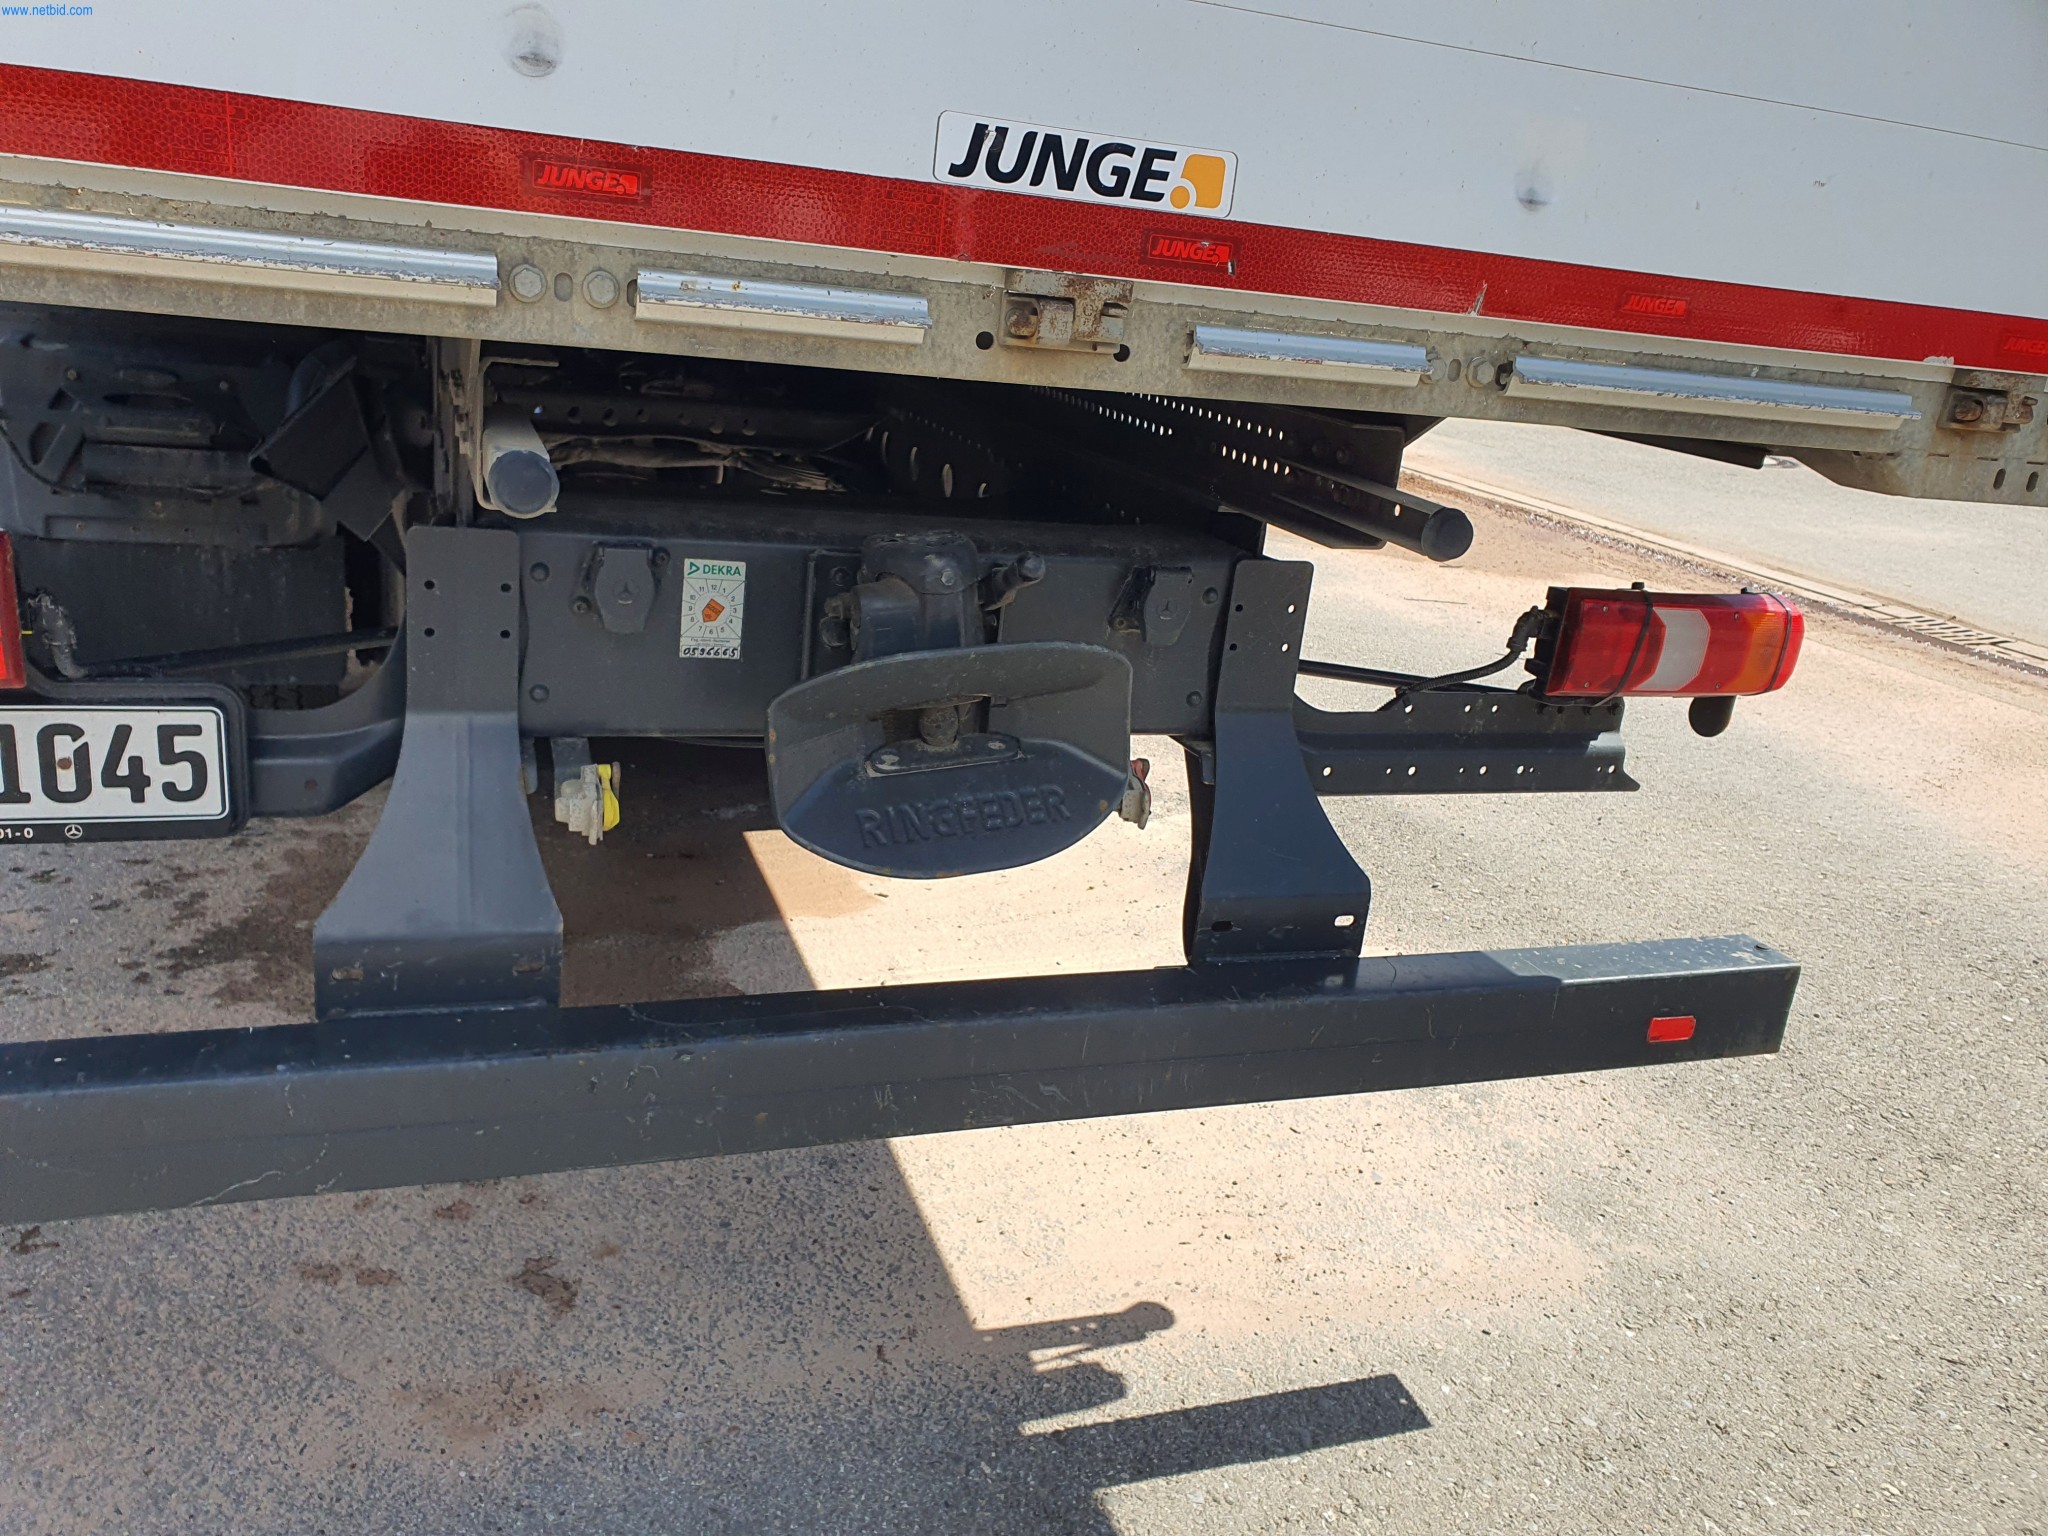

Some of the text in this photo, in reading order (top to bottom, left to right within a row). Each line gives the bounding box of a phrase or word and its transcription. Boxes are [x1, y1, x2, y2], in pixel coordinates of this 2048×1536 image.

[948, 122, 1177, 202] JUNGE
[536, 164, 620, 192] JUNGE
[1151, 239, 1215, 262] JUNGE
[1621, 294, 1676, 313] JUNGE
[702, 564, 742, 576] DEKRA
[0, 723, 208, 803] 1045
[854, 783, 1071, 849] RINGFEDER
